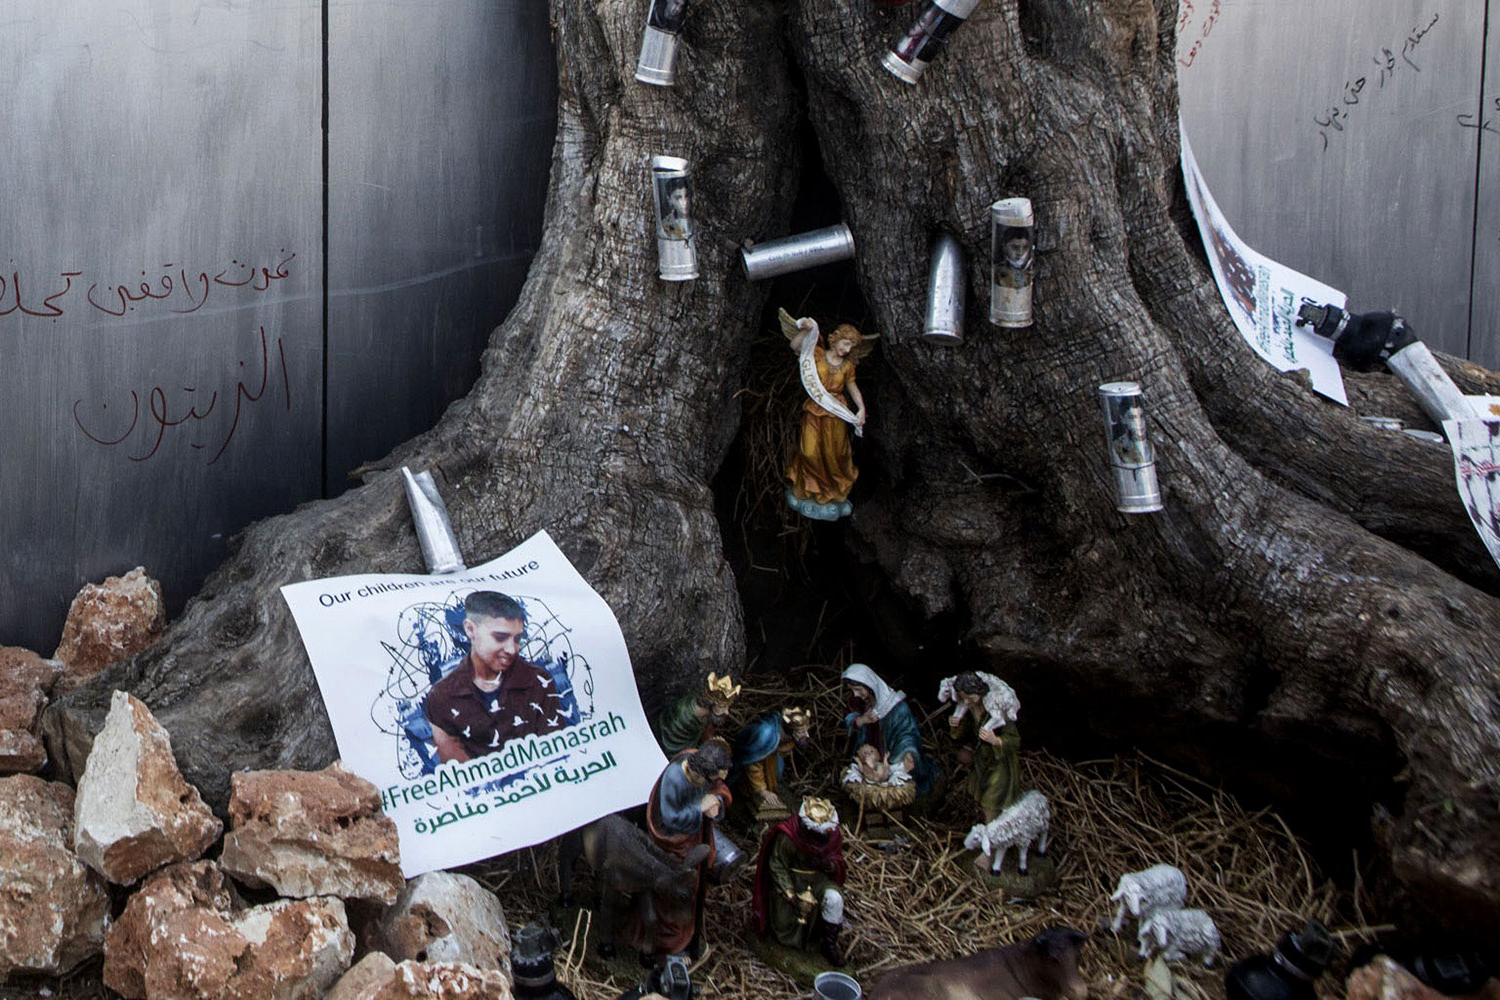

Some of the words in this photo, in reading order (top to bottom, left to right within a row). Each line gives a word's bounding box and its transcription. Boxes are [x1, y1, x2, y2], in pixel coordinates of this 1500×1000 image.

[88, 263, 209, 316] واقفين
[74, 326, 290, 465] الزيتون
[319, 589, 351, 608] Our
[357, 580, 426, 598] children
[429, 576, 456, 588] are
[460, 574, 488, 586] our
[489, 558, 540, 585] future
[381, 711, 627, 812] #FreeAhmadManasrah
[555, 751, 618, 786] الحرية
[494, 770, 553, 809] لأحمد
[413, 799, 490, 834] مناصرة
